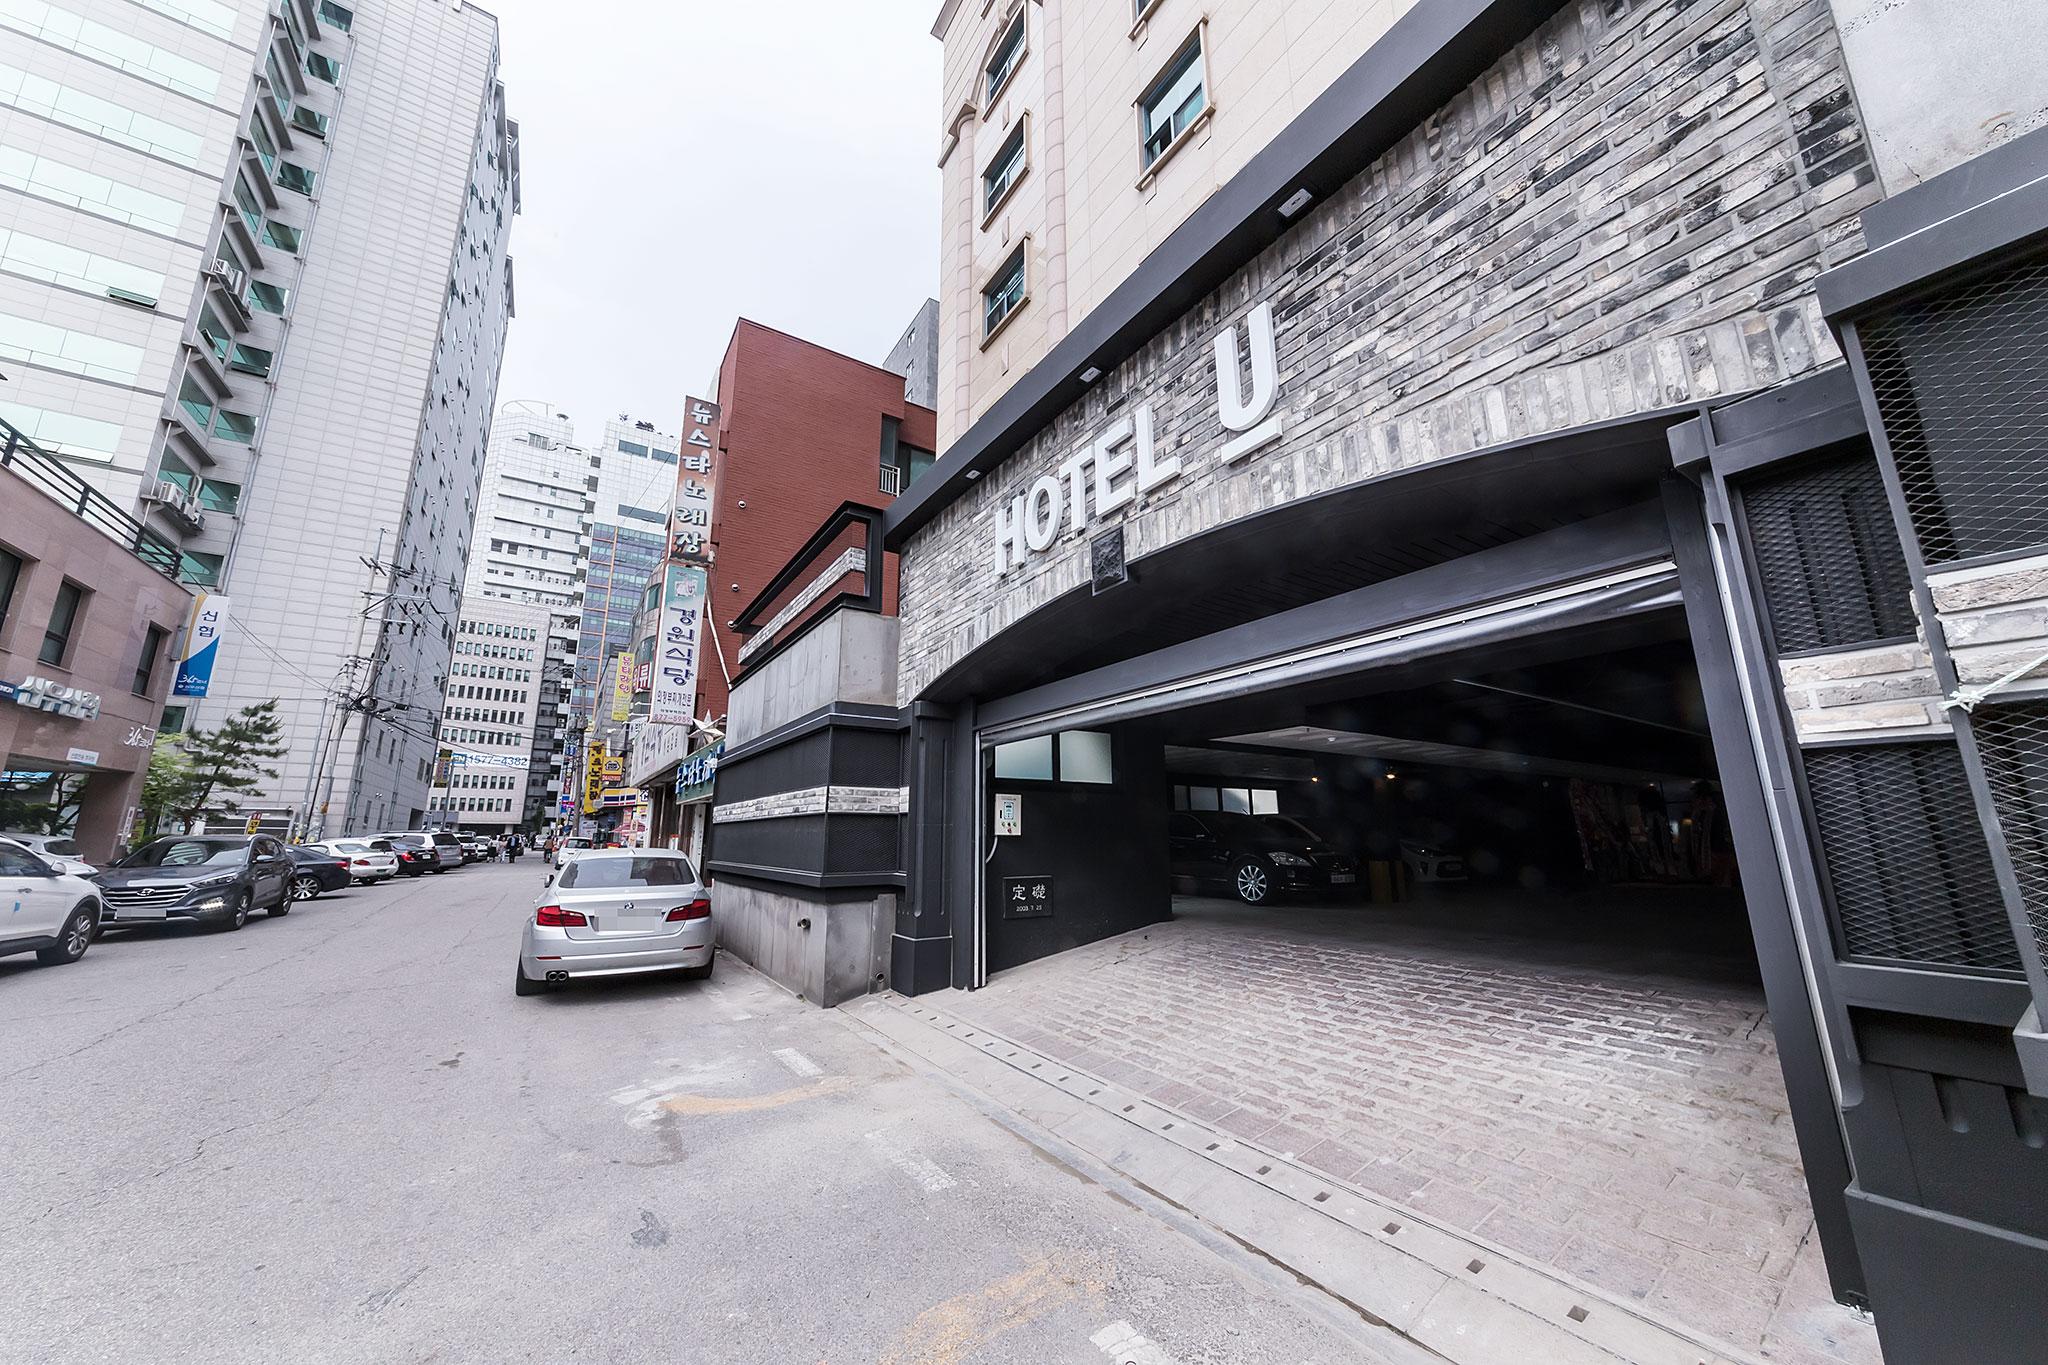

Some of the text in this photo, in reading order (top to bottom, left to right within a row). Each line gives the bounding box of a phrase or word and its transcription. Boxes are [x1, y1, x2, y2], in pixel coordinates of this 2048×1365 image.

[994, 300, 1279, 577] HOTEL U
[675, 402, 714, 554] 뉴스타노래장
[199, 610, 218, 637] 신협
[664, 606, 697, 686] 경원식당
[469, 754, 528, 766] 1577-4382
[1012, 884, 1046, 900] 定礎
